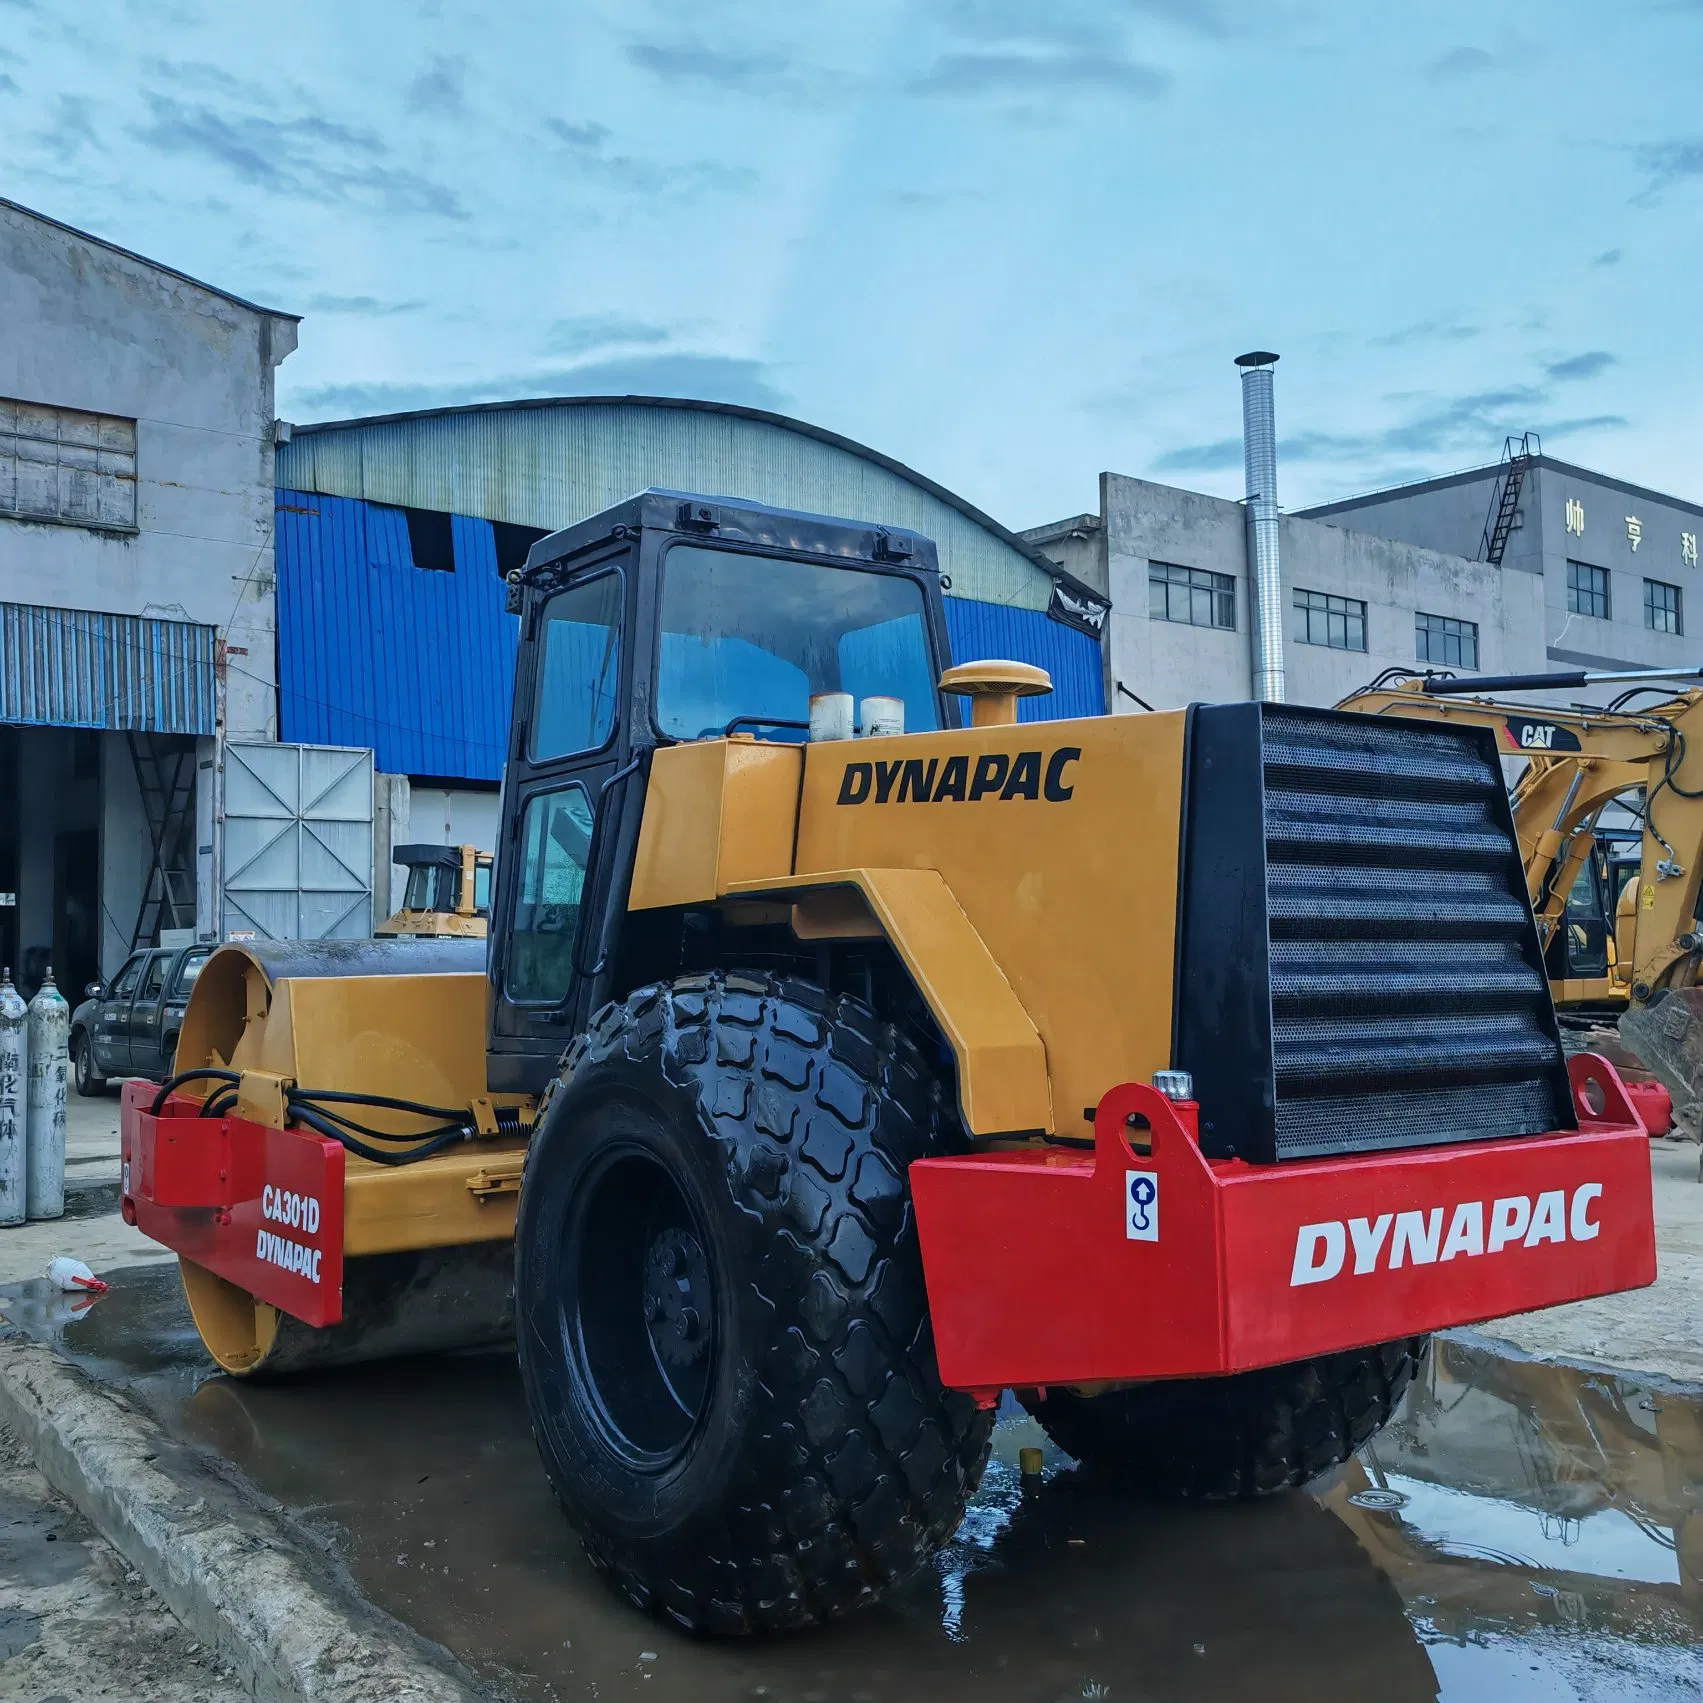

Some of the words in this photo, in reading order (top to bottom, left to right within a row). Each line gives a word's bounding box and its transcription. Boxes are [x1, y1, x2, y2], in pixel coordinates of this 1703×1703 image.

[1521, 725, 1556, 748] CAT
[836, 746, 1082, 805] DYNAPAC
[262, 1184, 320, 1234] CA301D
[1289, 1182, 1603, 1287] DYNAPAC
[256, 1228, 322, 1284] DYNAPAC
